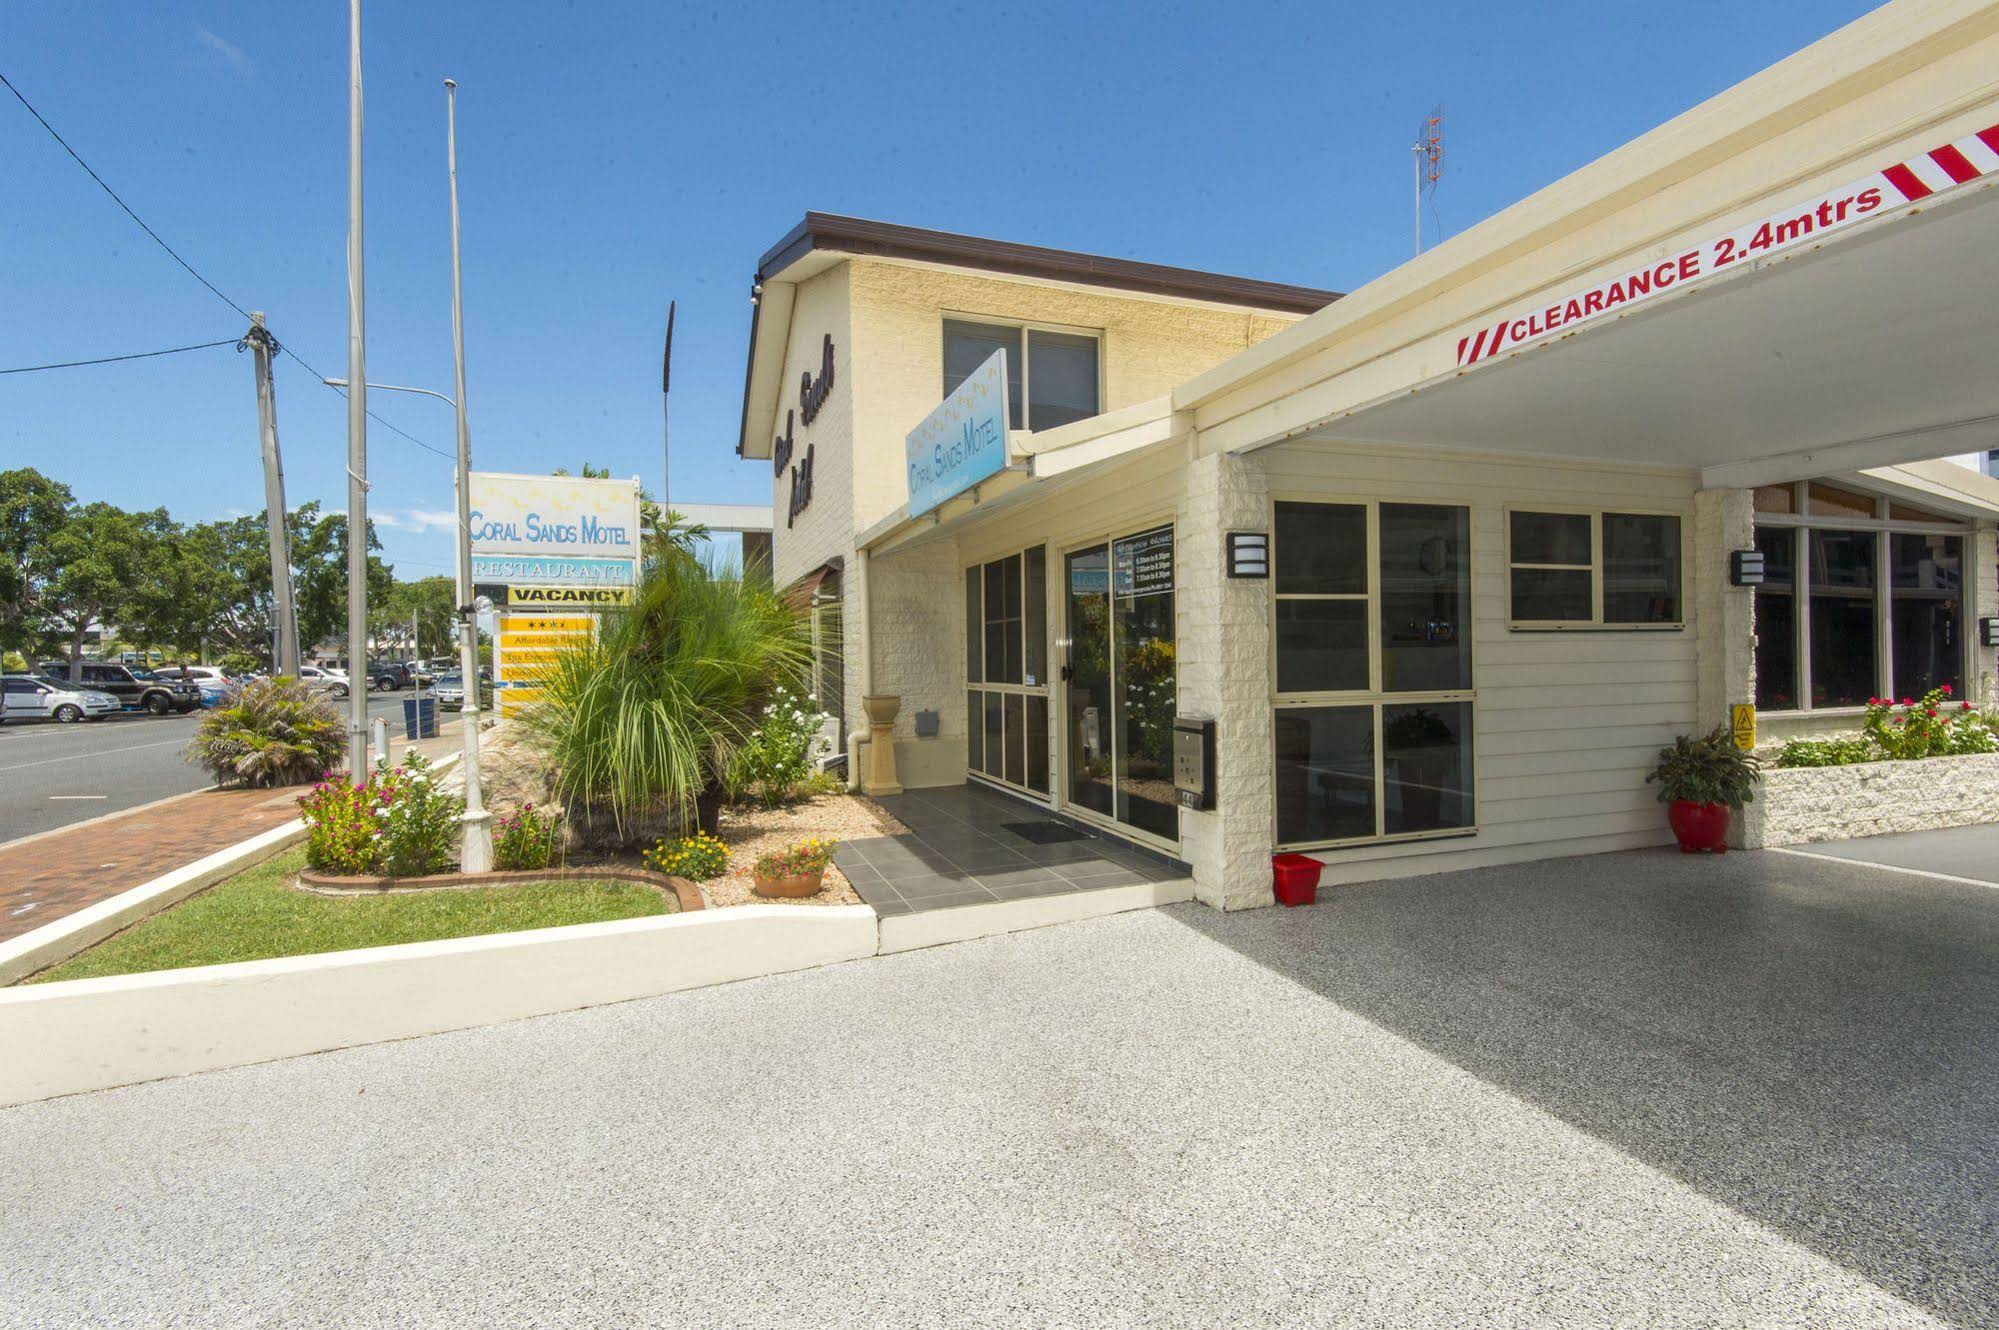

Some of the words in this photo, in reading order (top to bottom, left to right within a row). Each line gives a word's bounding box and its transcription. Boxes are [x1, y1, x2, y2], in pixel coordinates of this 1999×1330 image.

[1510, 250, 1700, 342] CLEARANCE
[1713, 187, 1882, 268] 2.4mtrs
[962, 416, 998, 460] MOTEL
[470, 510, 521, 542] CORAL
[525, 512, 578, 543] SANDS
[581, 514, 631, 545] MOTEL
[473, 560, 626, 579] RESTAURANT
[514, 589, 625, 602] VACANCY
